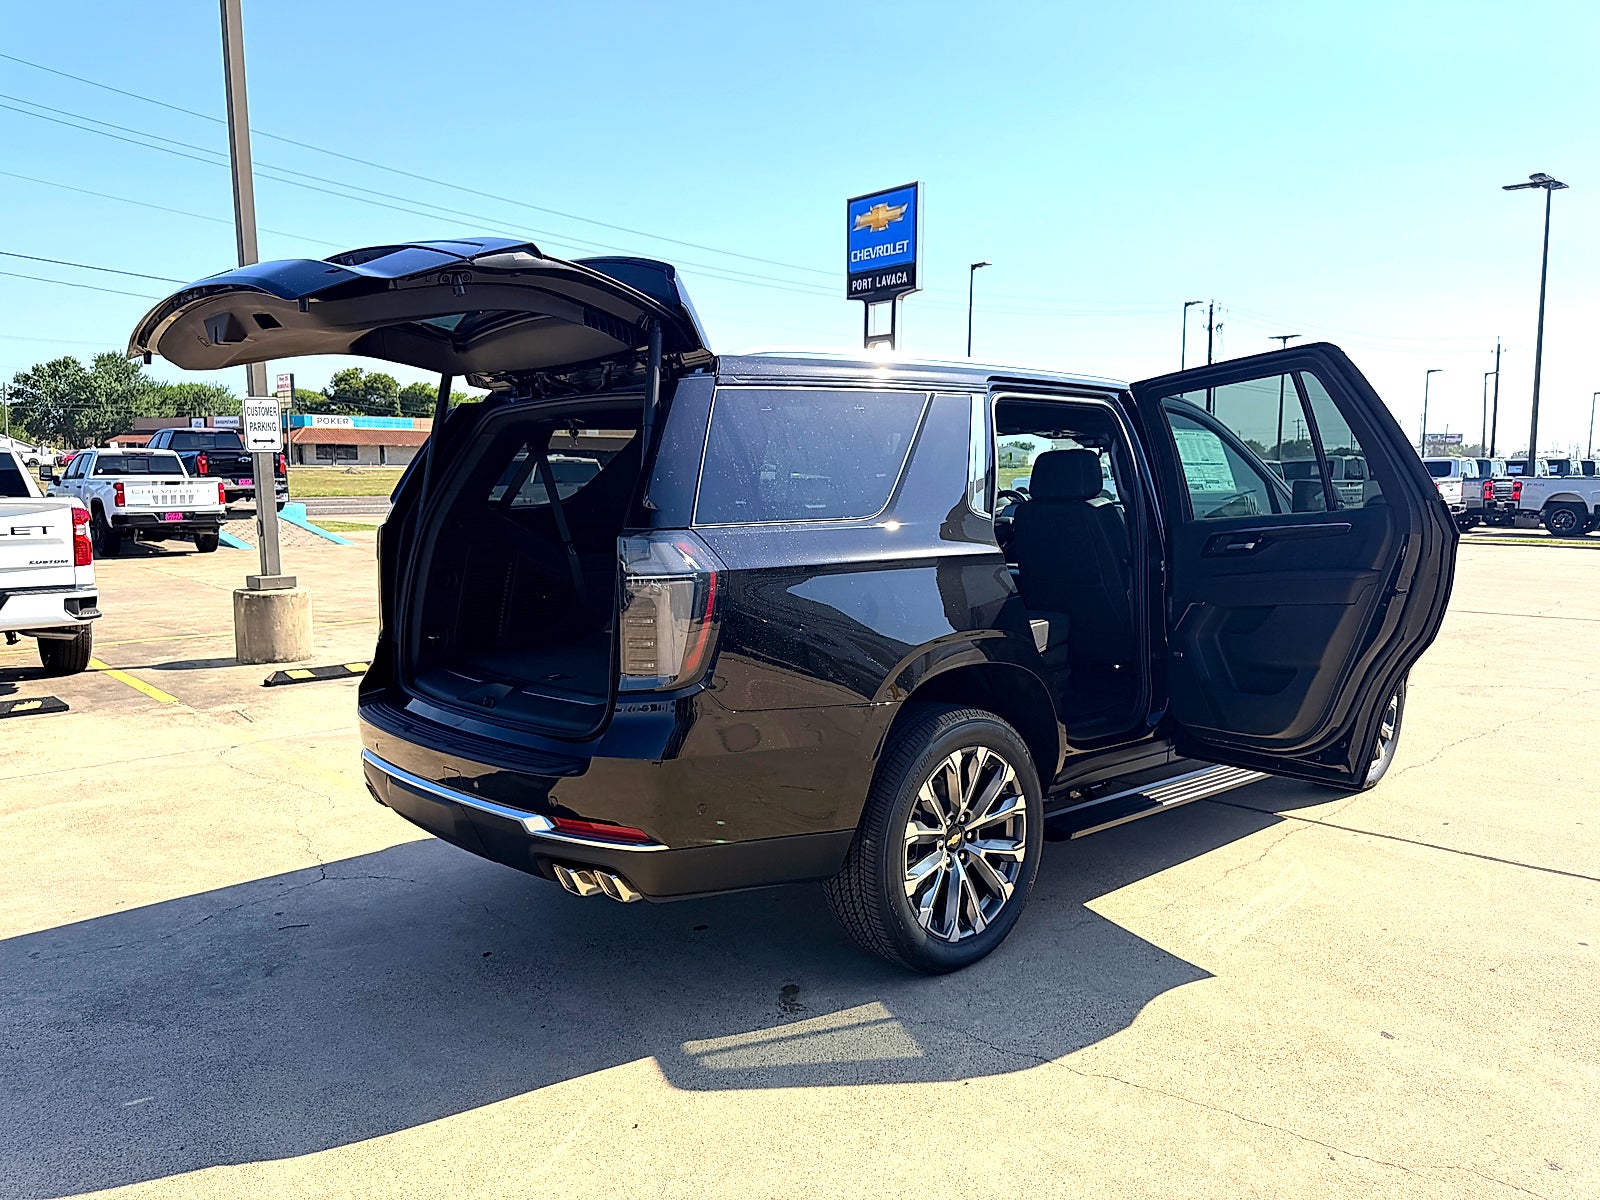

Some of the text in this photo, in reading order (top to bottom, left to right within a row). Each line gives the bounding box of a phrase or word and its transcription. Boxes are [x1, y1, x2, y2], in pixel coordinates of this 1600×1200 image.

[851, 240, 909, 262] CHEVROLET
[852, 271, 908, 291] PORT LAVACA
[246, 406, 278, 417] CUSTOMER
[249, 421, 277, 432] PARKING
[316, 417, 349, 425] POKER
